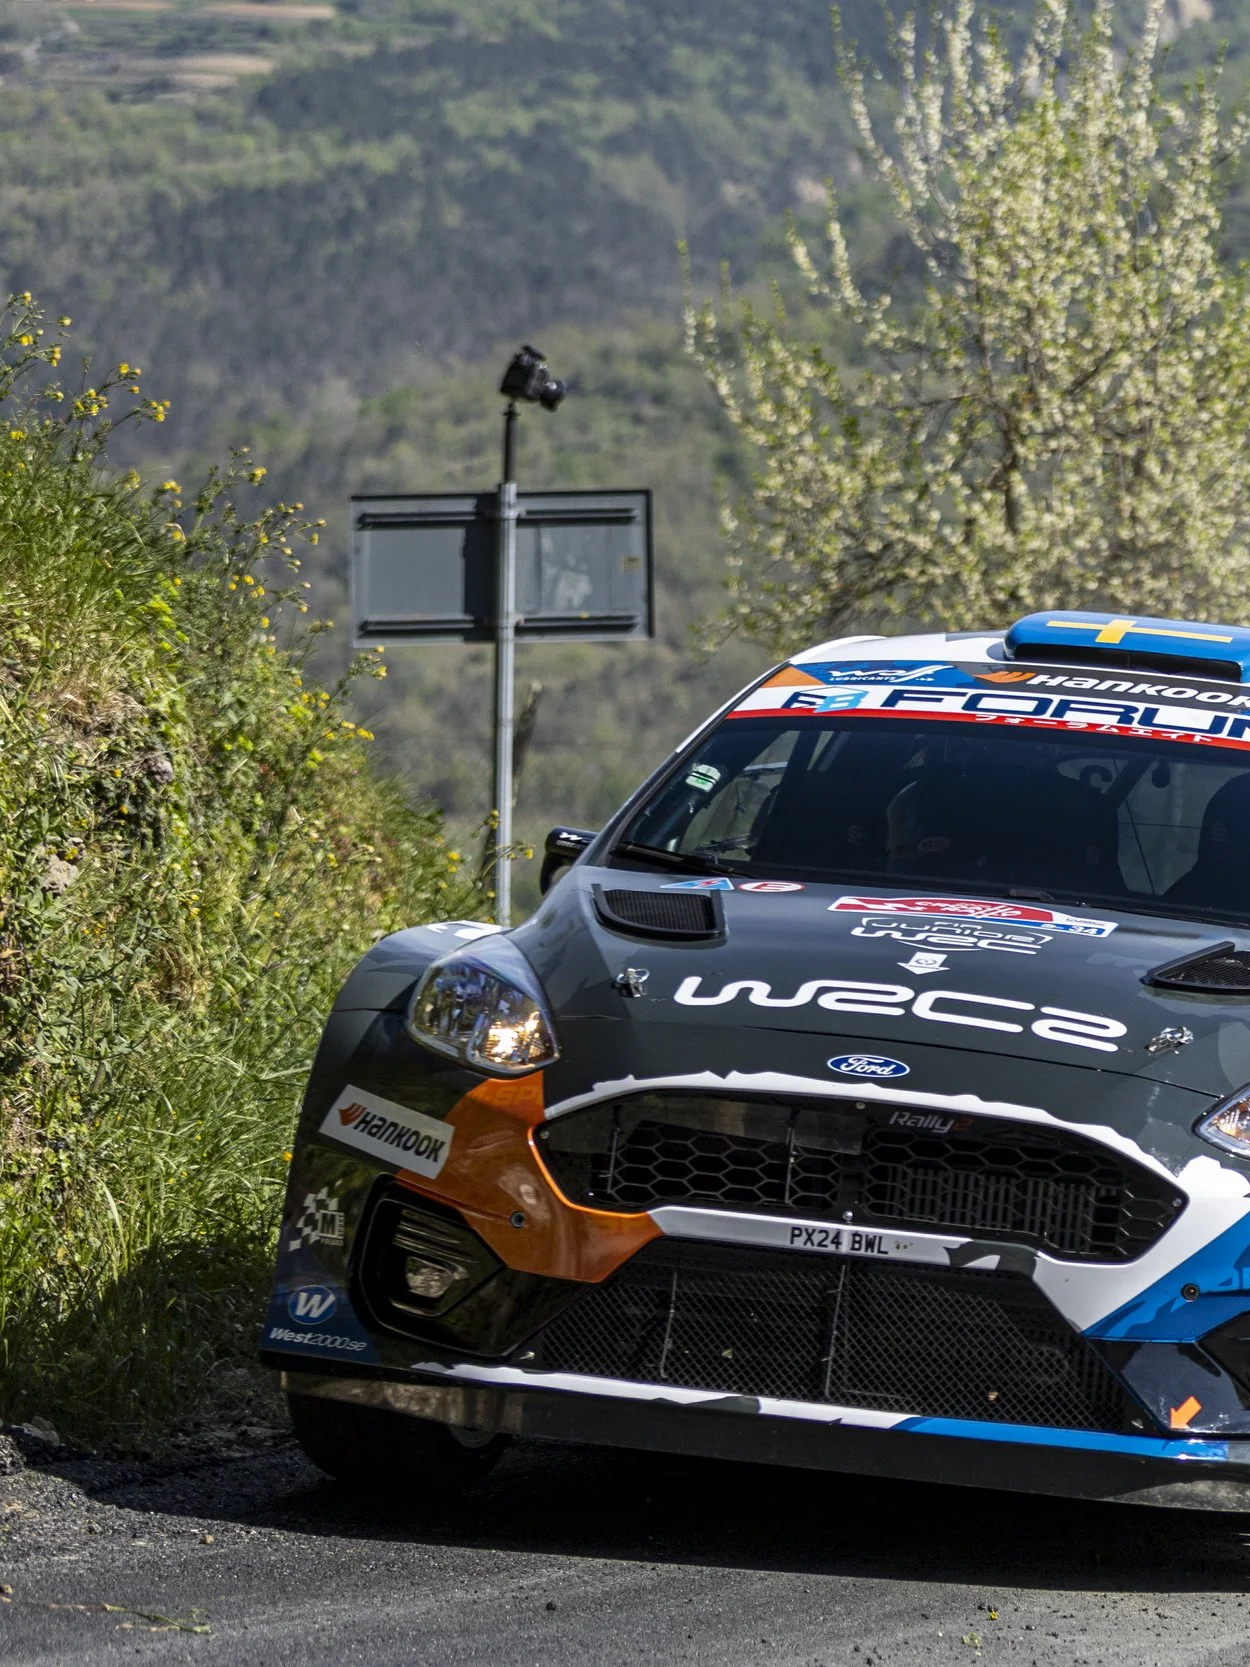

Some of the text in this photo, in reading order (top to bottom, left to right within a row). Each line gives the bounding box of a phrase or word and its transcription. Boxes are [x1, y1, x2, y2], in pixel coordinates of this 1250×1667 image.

[975, 714, 1213, 743] フォーラムエイト
[840, 1057, 897, 1075] Ford
[889, 1111, 972, 1134] Rally2
[790, 1226, 889, 1255] PX24 BWL
[295, 1292, 336, 1318] W
